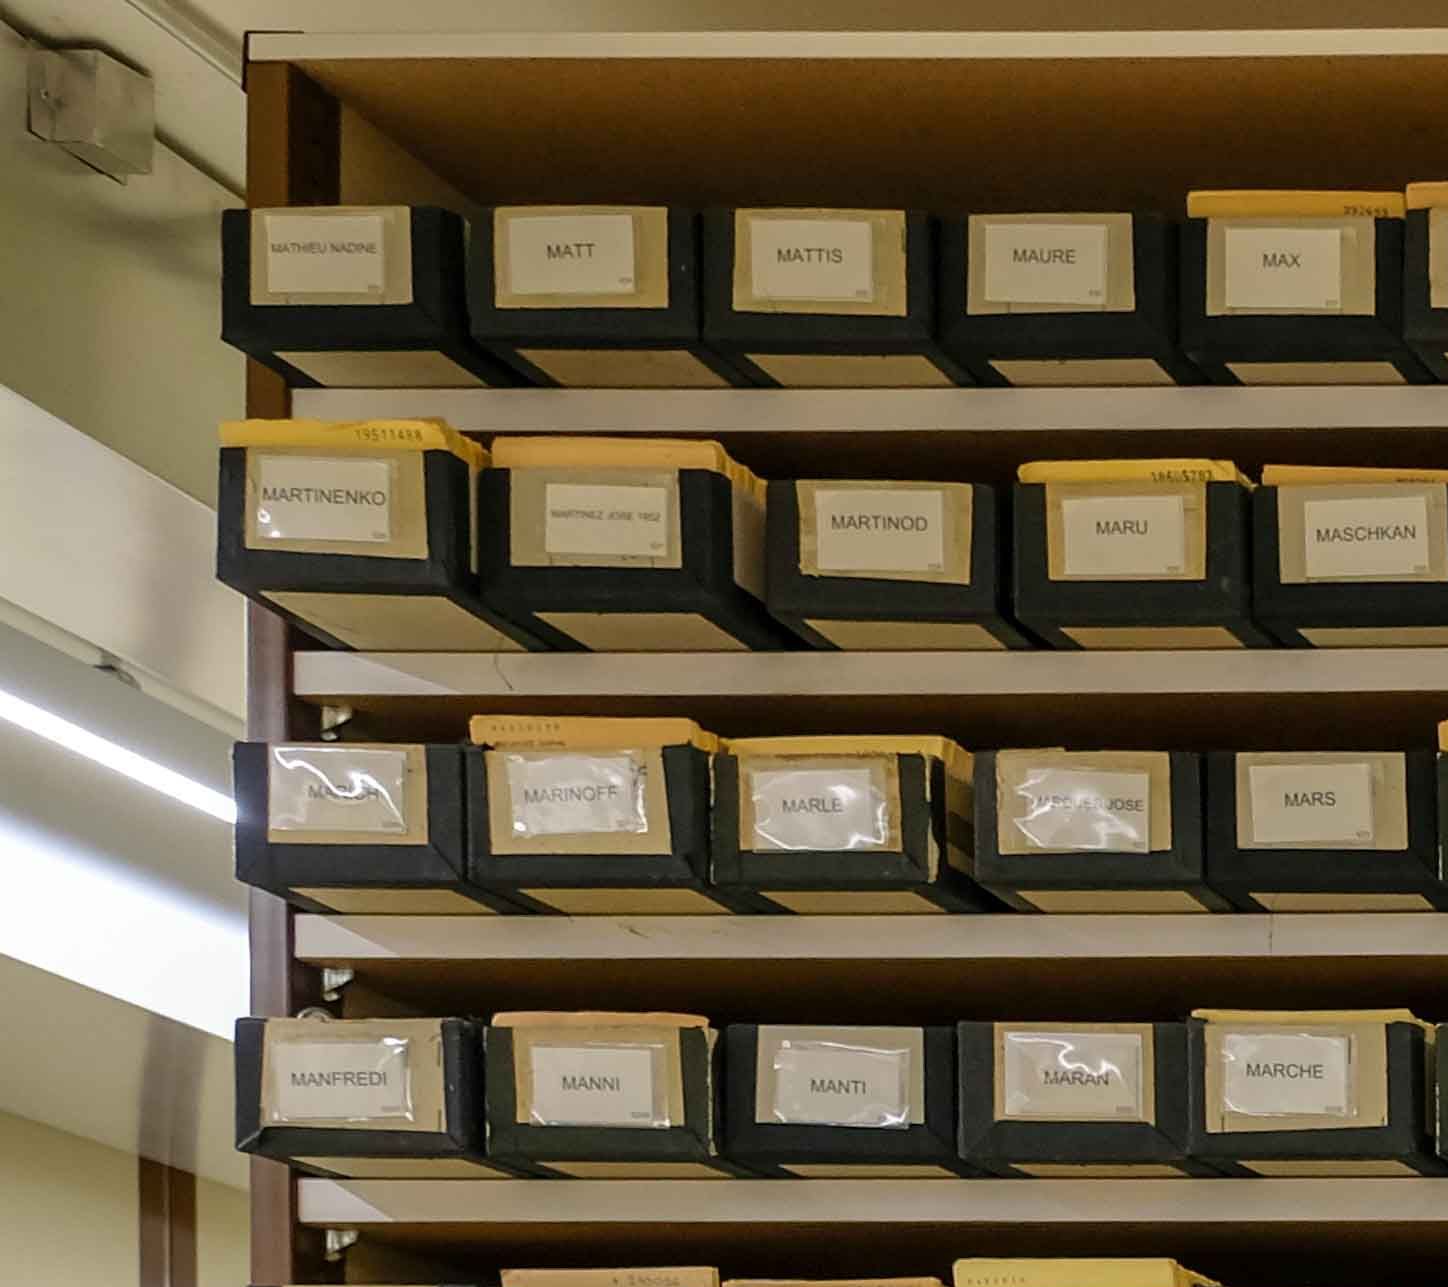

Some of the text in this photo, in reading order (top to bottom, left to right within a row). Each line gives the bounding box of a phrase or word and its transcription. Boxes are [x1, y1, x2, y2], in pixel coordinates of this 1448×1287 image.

[546, 242, 596, 260] MATT
[1262, 252, 1301, 269] MAX
[831, 514, 929, 532] MARTINOD
[1284, 791, 1337, 808] MARS
[810, 1079, 867, 1095] MANTI
